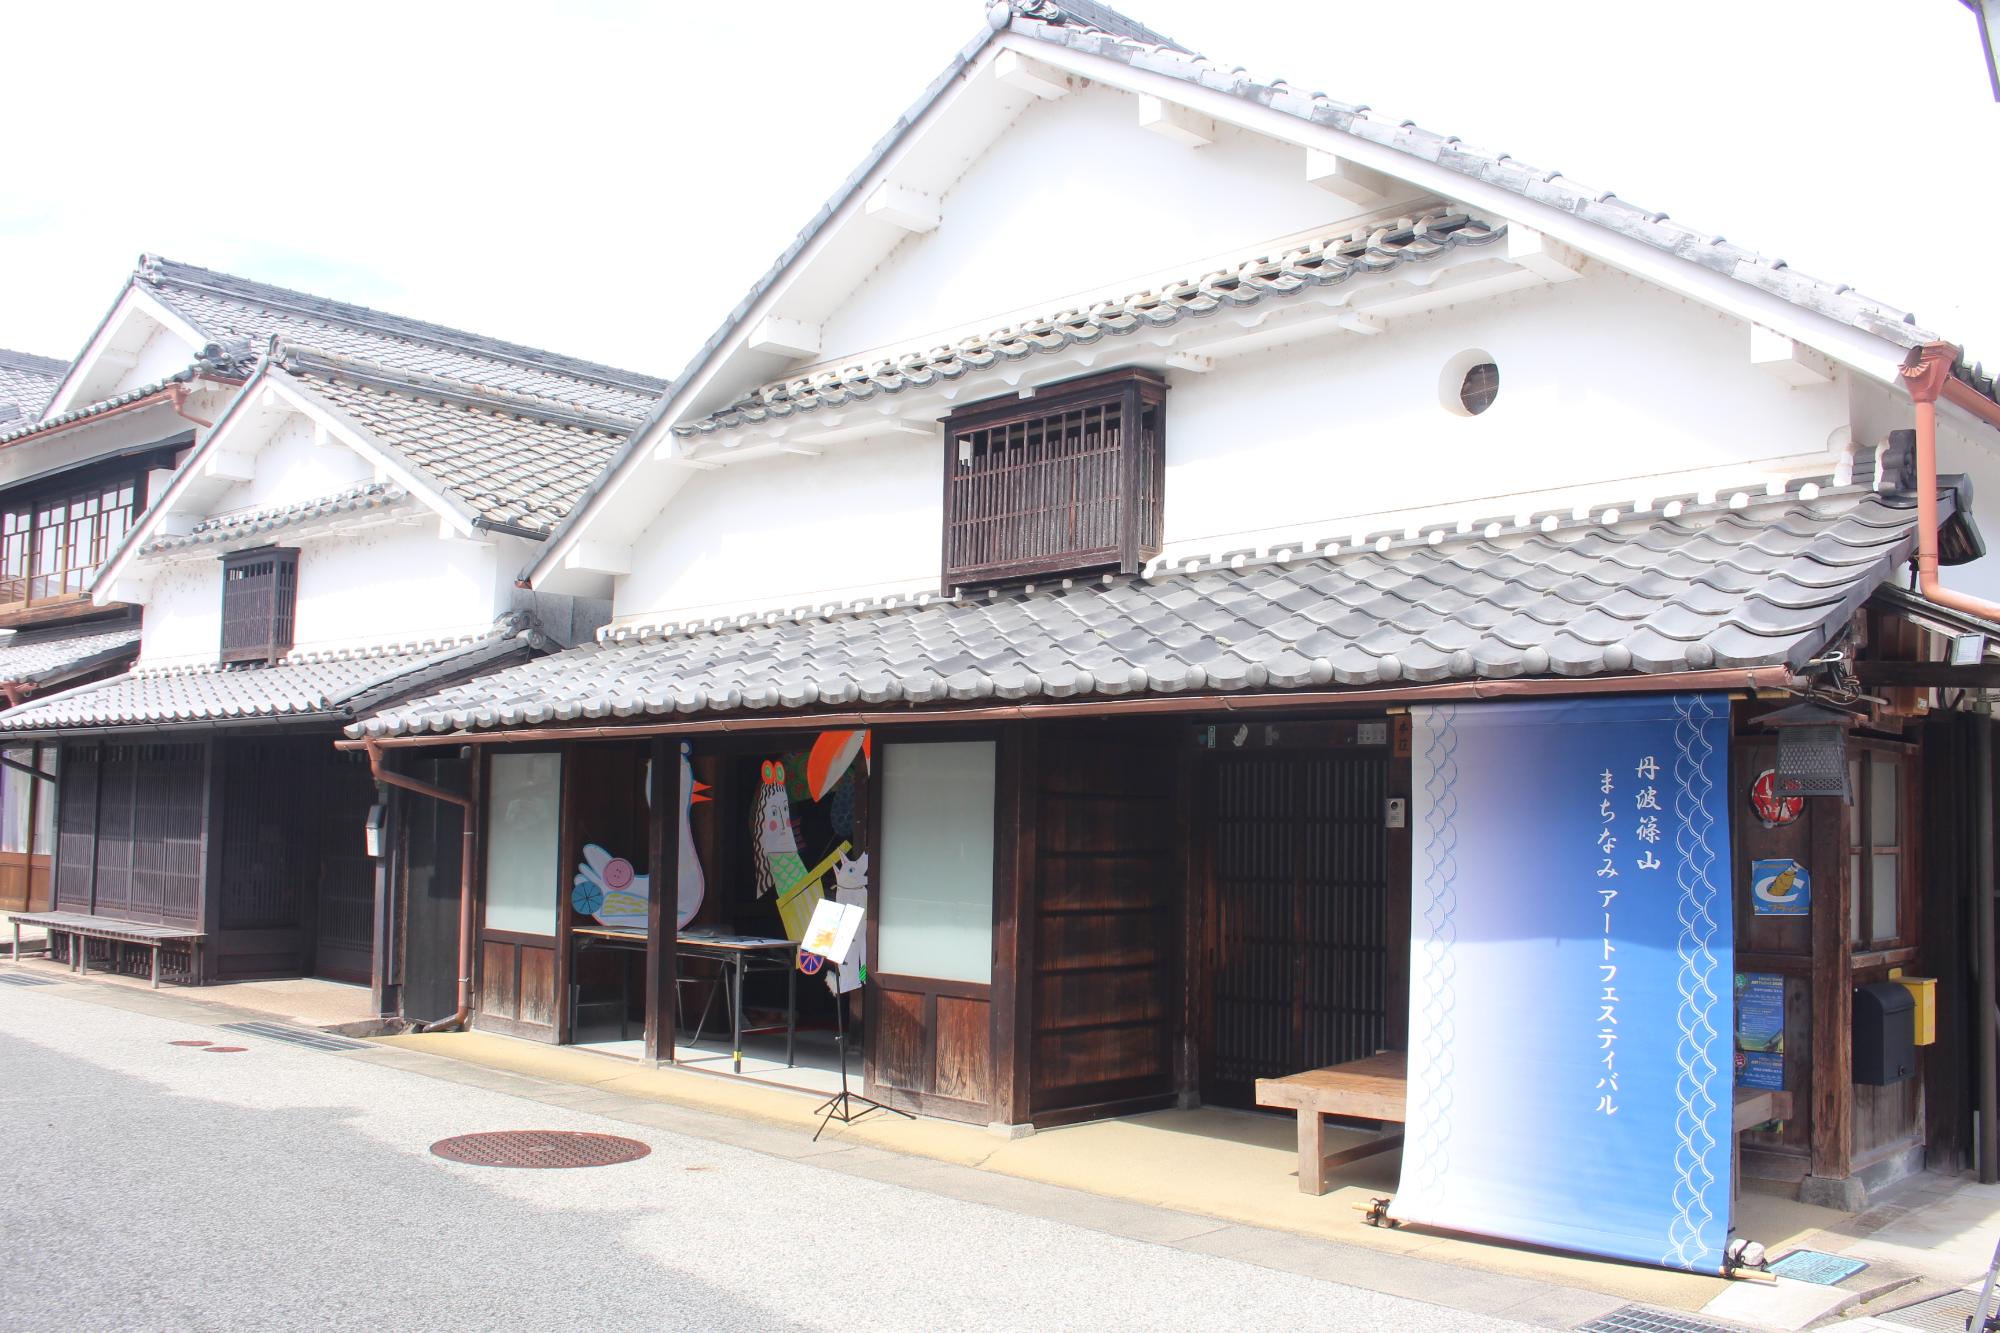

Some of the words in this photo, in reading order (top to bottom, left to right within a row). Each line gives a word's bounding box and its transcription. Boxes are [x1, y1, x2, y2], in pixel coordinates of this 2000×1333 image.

[1596, 768, 1619, 879] まちなみ
[1635, 756, 1662, 870] 丹波篠山
[1595, 889, 1620, 1116] アートフェスティバル
